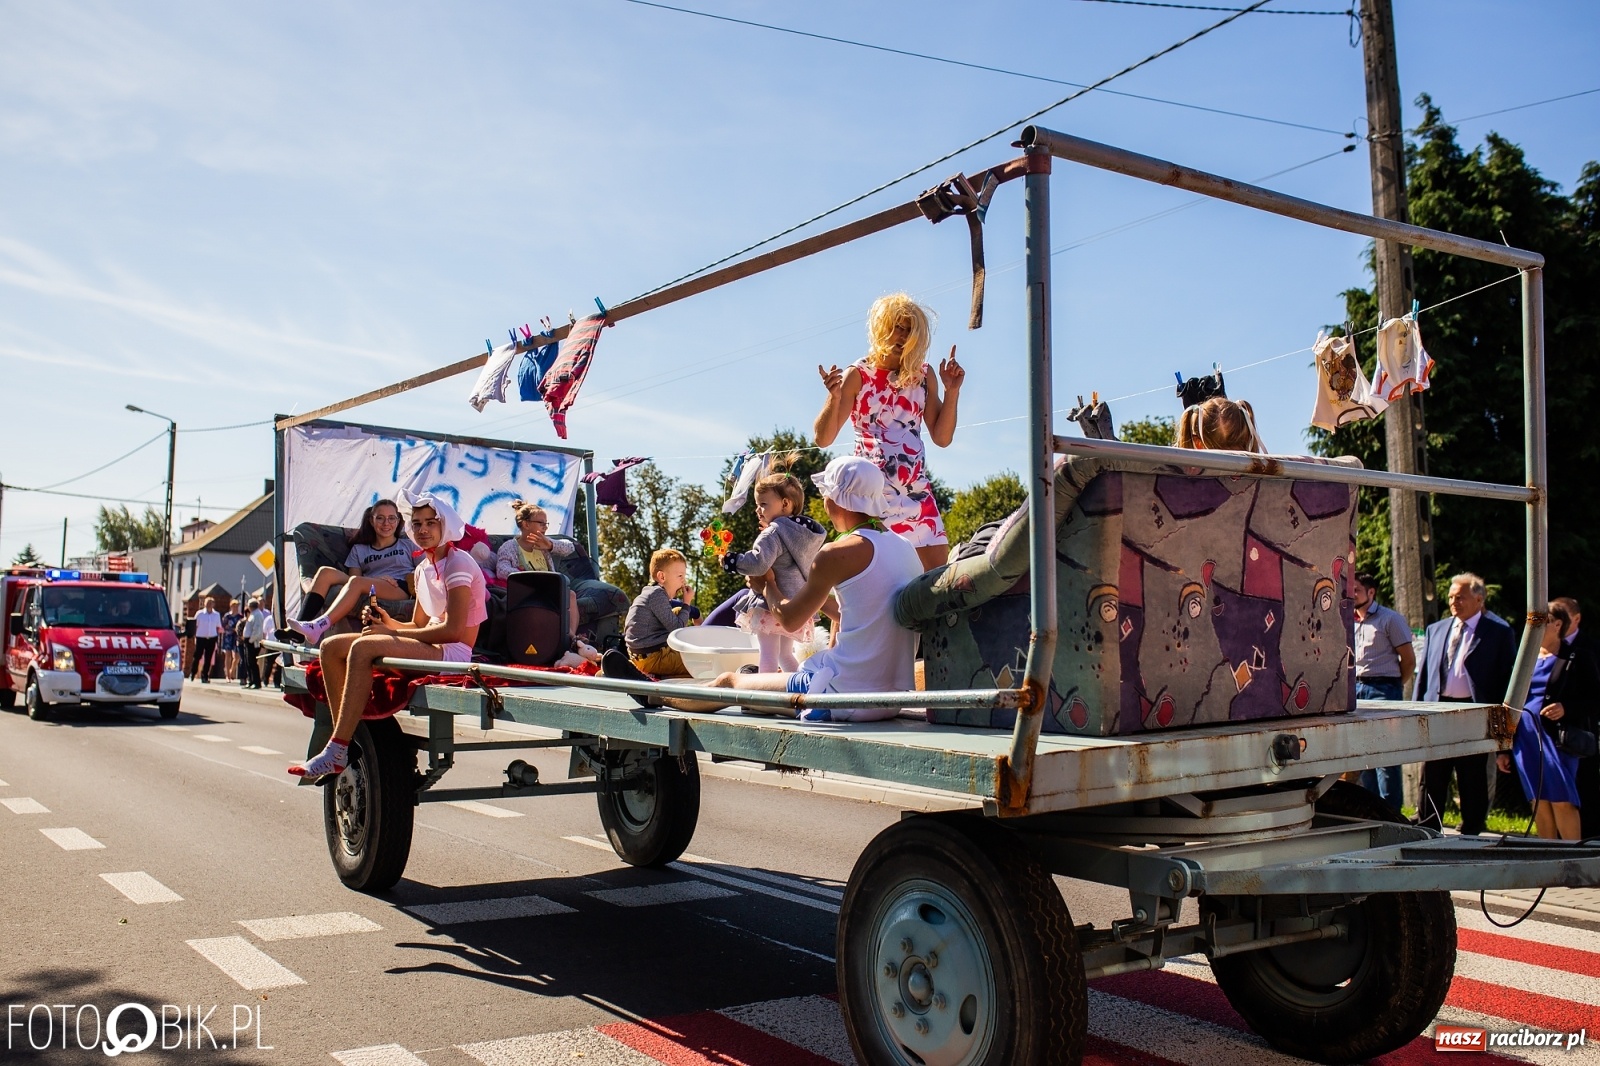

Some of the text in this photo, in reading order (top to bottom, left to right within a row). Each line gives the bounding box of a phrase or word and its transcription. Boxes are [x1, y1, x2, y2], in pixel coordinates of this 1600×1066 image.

[363, 549, 404, 565] NEW KIDS
[77, 635, 163, 650] STRAŻ
